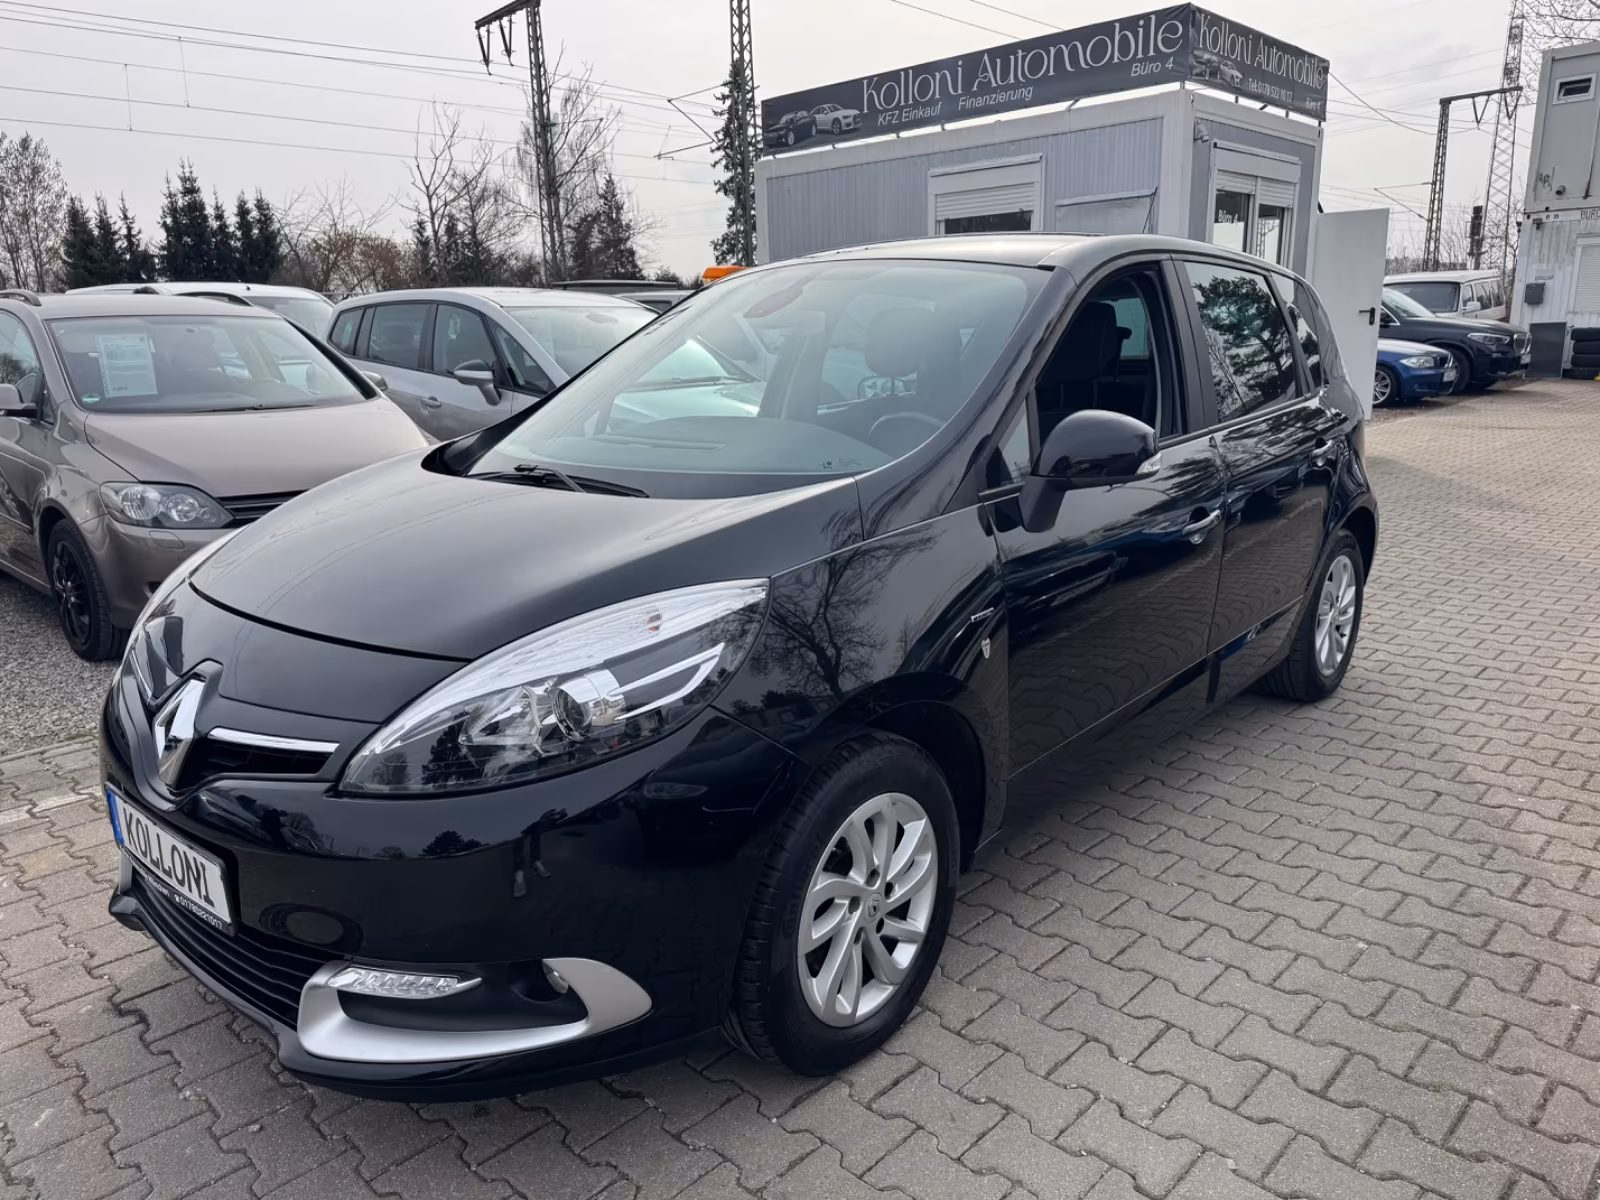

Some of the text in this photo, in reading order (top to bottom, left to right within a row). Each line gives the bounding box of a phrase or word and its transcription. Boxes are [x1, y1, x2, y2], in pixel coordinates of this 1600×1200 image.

[862, 14, 1183, 113] Kolloni Automobile
[1131, 56, 1174, 77] Büro 4
[1199, 13, 1326, 89] Kolloni Automobile
[877, 101, 943, 127] KFZ Einkauf
[958, 85, 1034, 111] Finanzierung
[123, 805, 215, 908] KOLLONI
